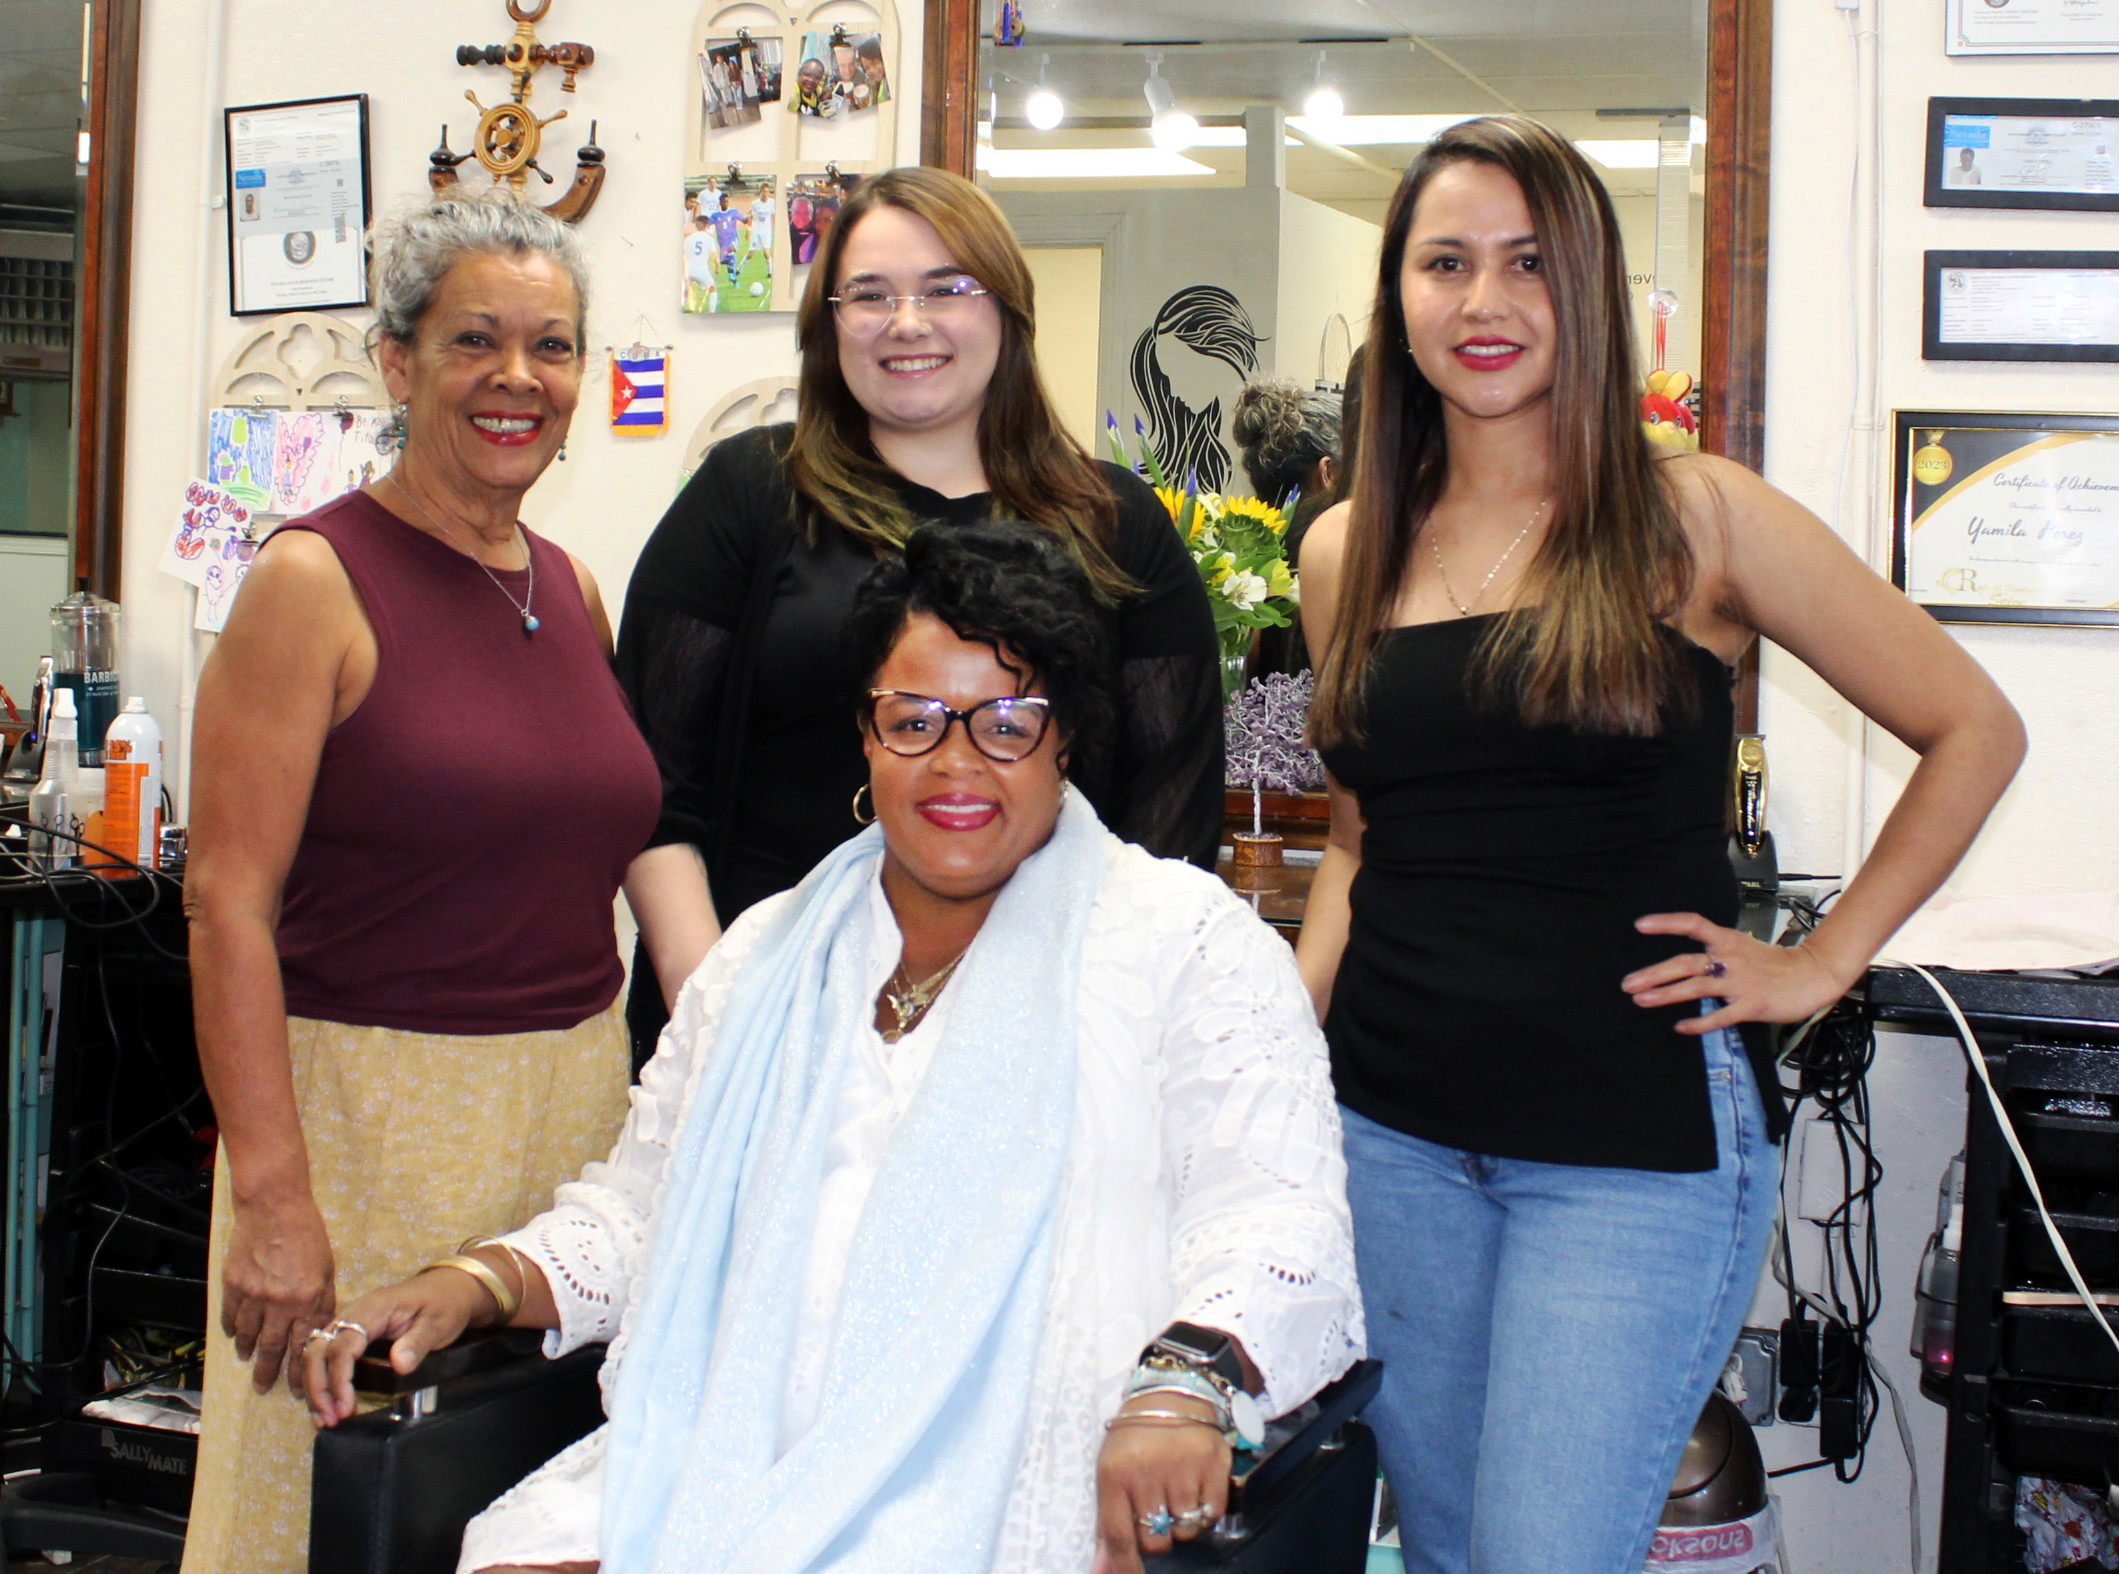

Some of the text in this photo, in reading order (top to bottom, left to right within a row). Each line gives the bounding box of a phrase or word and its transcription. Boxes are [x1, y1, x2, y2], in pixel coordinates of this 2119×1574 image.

[694, 241, 703, 256] 5
[620, 351, 660, 360] CUBA
[1993, 472, 2049, 492] Certificate
[2053, 476, 2068, 493] of
[1967, 516, 2028, 545] Yamila
